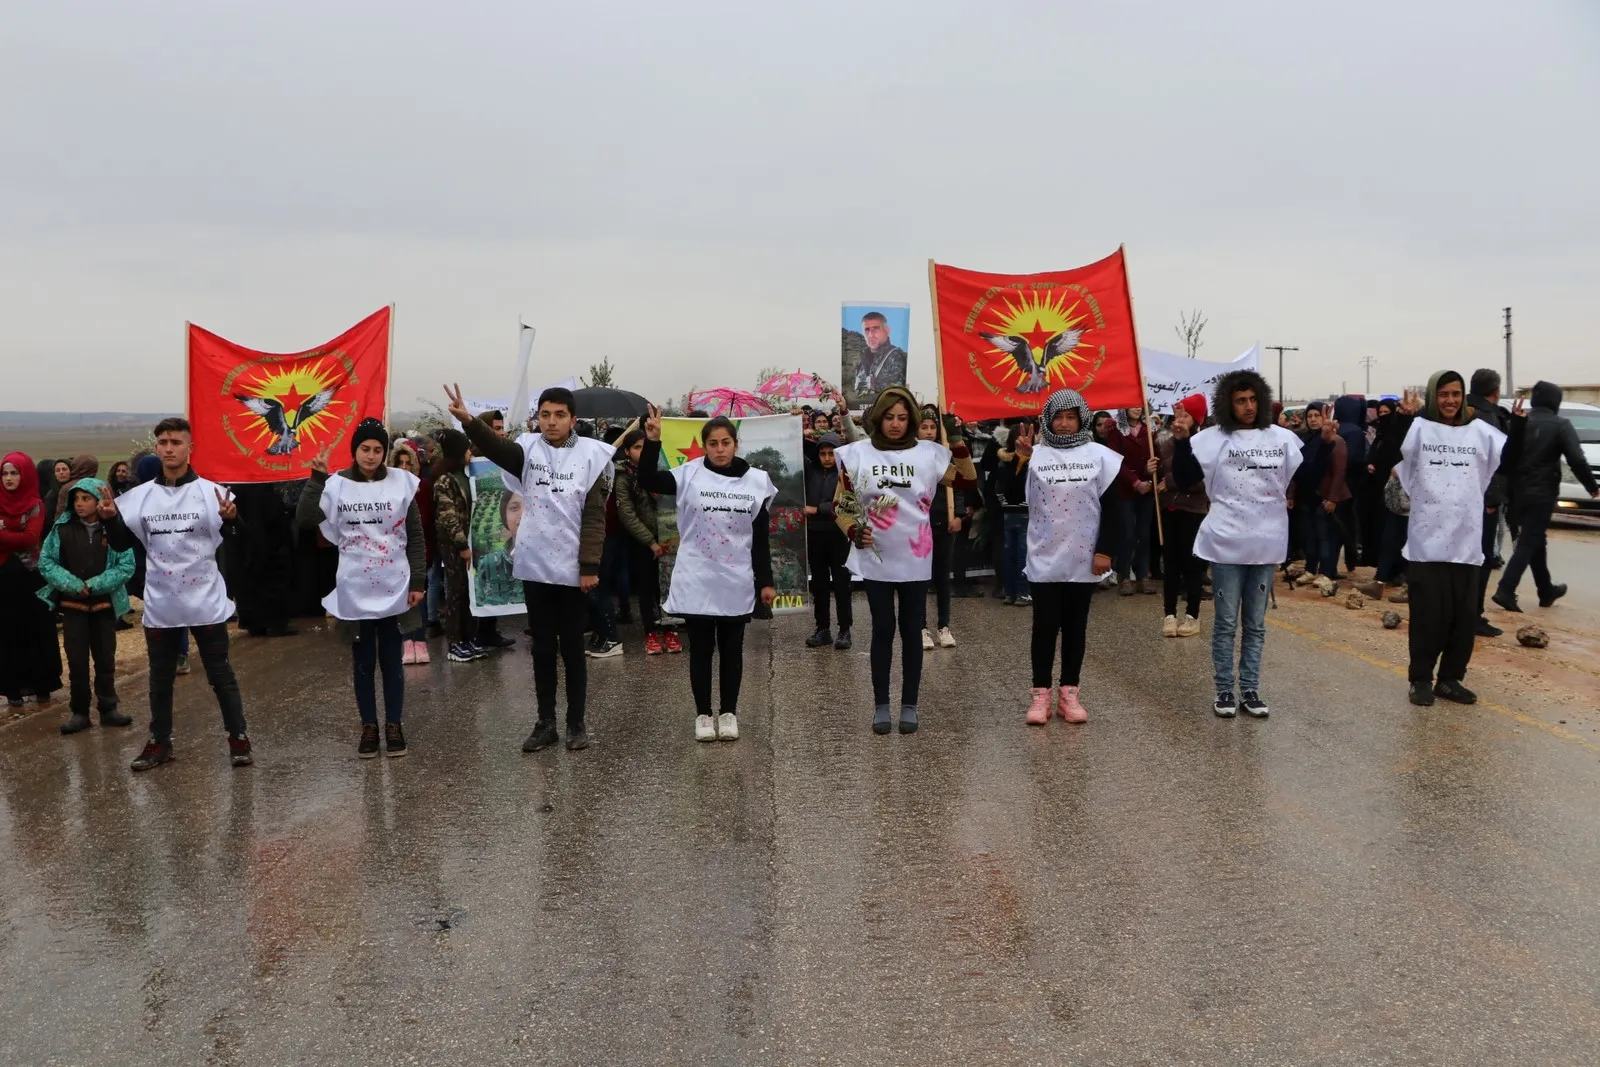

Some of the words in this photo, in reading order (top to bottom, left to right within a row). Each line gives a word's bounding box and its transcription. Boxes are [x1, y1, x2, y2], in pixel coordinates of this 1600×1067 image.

[1147, 380, 1181, 395] الشعوب
[1228, 449, 1264, 459] NAVÇEYA
[1422, 443, 1456, 454] NAVÇEYA
[1457, 447, 1477, 455] RECO
[872, 462, 915, 477] EFRÎN
[1037, 463, 1068, 472] NAVÇEYA
[877, 477, 911, 489] عفرين
[700, 490, 728, 499] NAVÇEYA
[337, 502, 373, 514] NAVÇEYA
[142, 514, 171, 523] NAVÇEYA
[171, 512, 200, 521] MABETA
